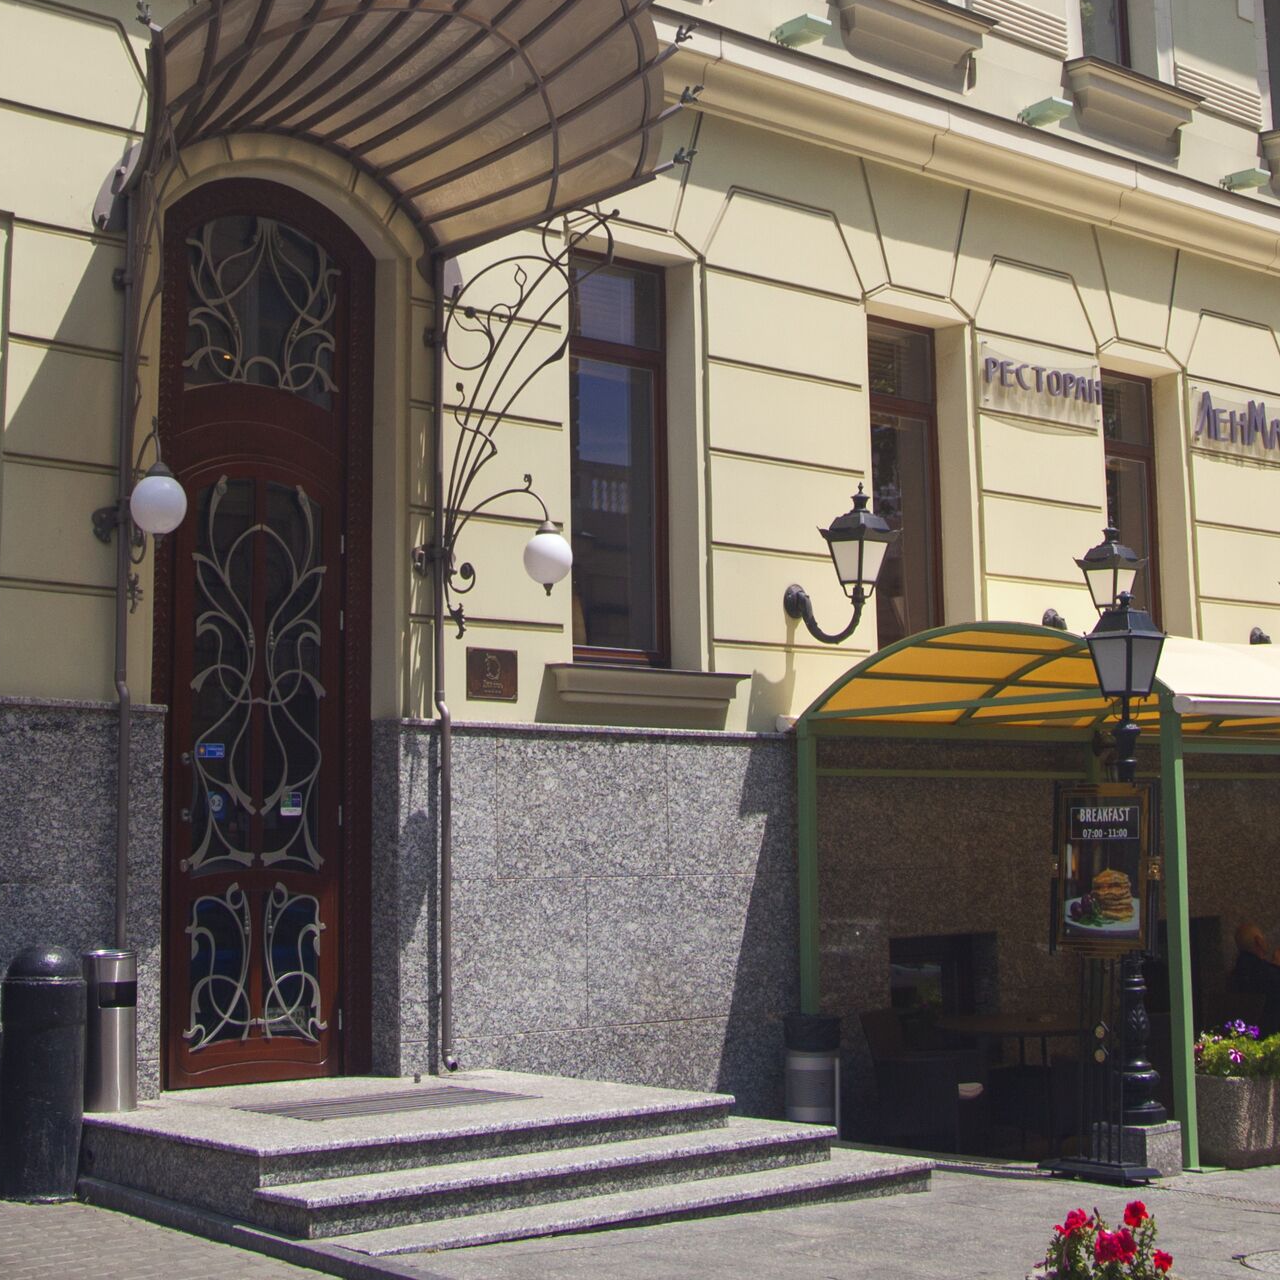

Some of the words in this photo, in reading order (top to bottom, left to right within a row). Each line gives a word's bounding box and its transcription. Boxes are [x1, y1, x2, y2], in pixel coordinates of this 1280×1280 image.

[984, 357, 1103, 405] РЕСТОРАН
[1080, 807, 1130, 822] BREAKFAST
[1082, 828, 1103, 838] 07:00
[1108, 828, 1128, 838] 11:00
